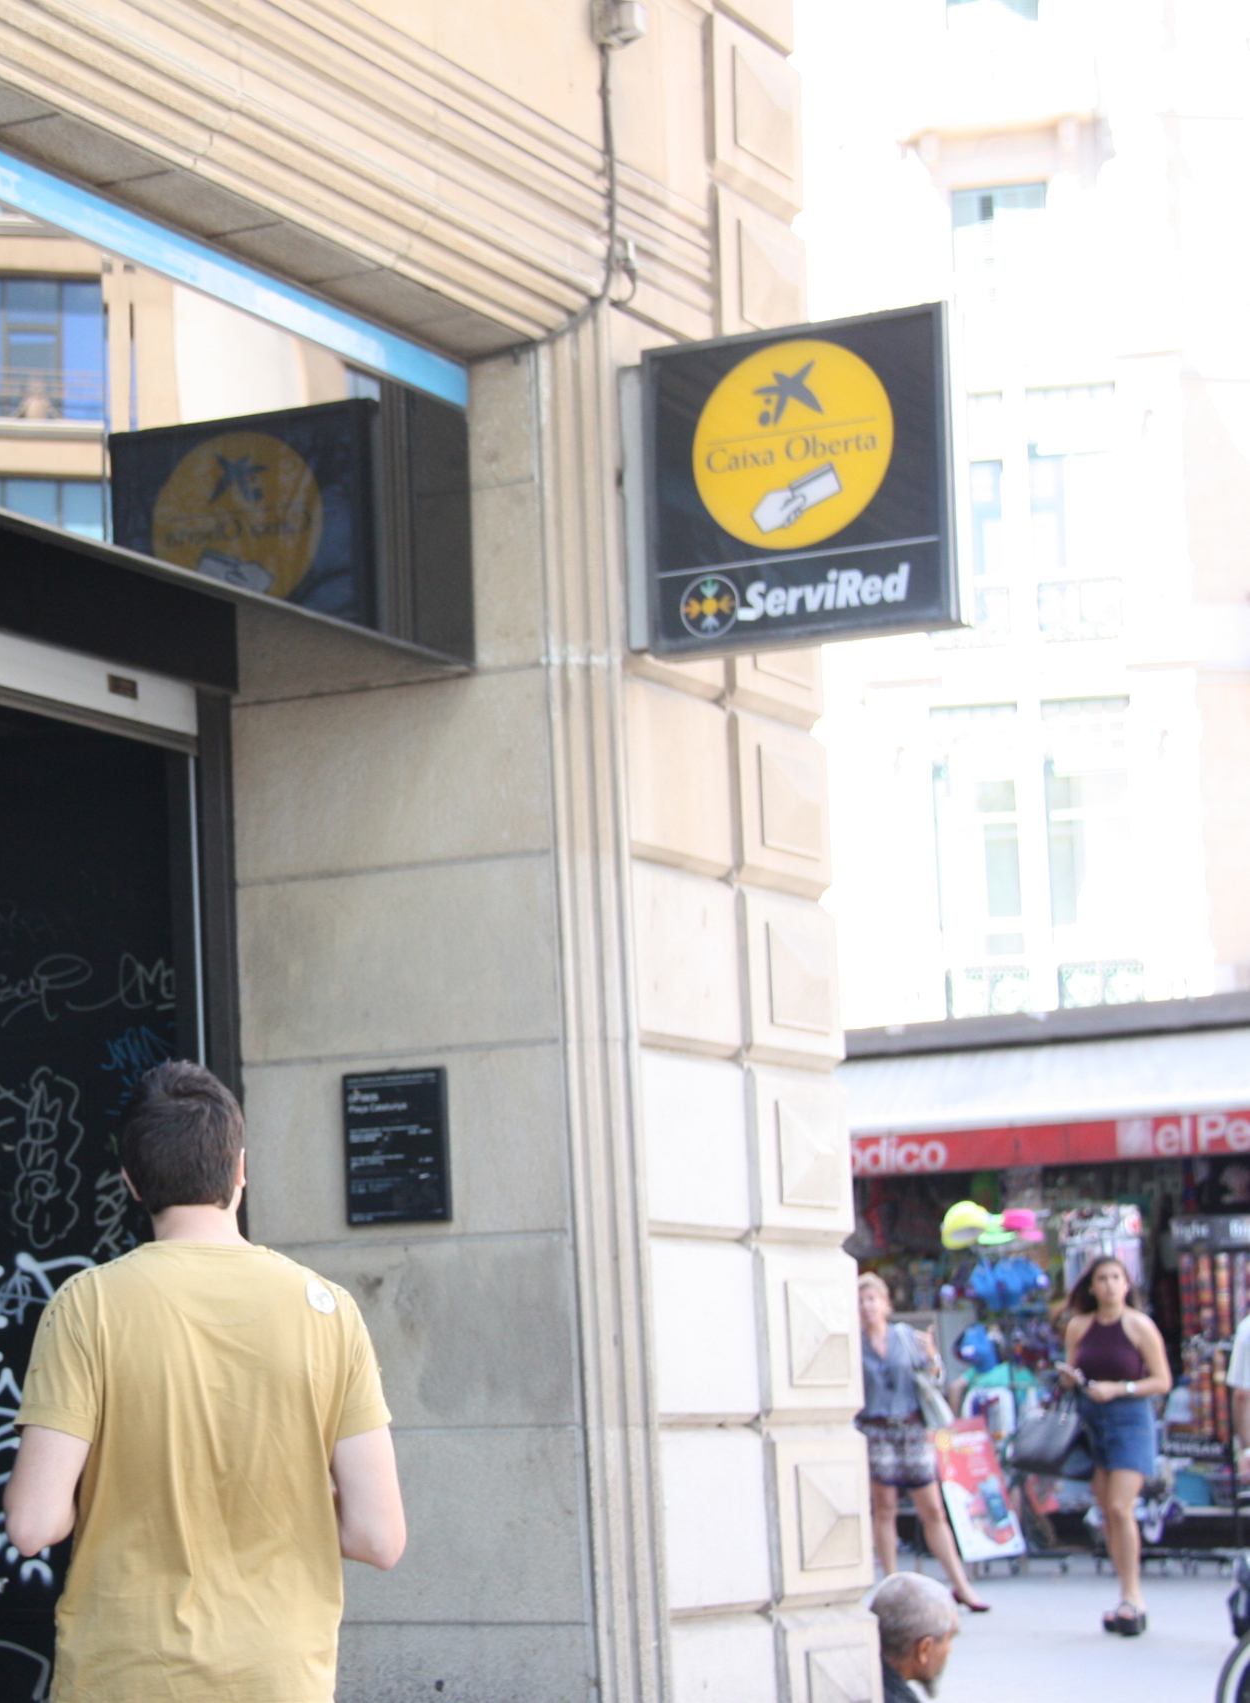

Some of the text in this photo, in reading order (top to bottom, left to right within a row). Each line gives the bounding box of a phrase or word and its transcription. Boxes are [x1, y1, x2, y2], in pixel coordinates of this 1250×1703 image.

[705, 432, 878, 474] Caixa Oberta
[737, 562, 911, 622] ServiRed
